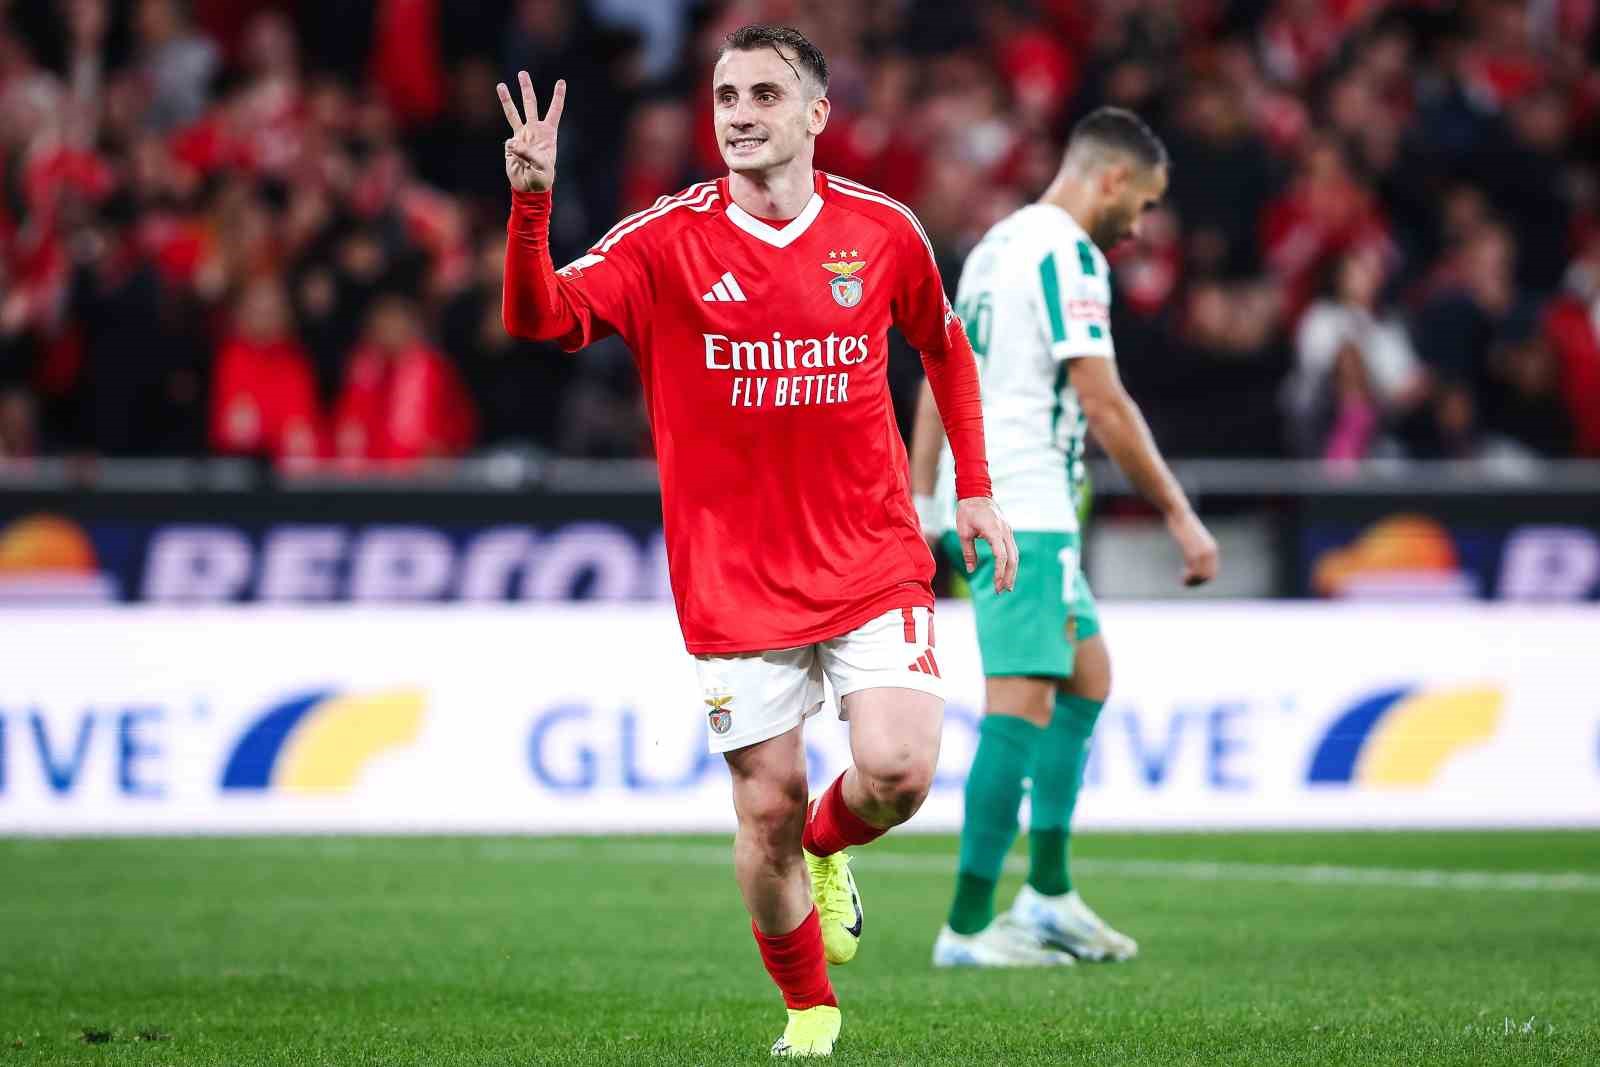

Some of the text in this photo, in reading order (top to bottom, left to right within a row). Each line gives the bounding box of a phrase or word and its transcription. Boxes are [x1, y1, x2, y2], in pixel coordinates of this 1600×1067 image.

[702, 331, 869, 370] Emirates
[731, 372, 849, 407] FLY BETTER
